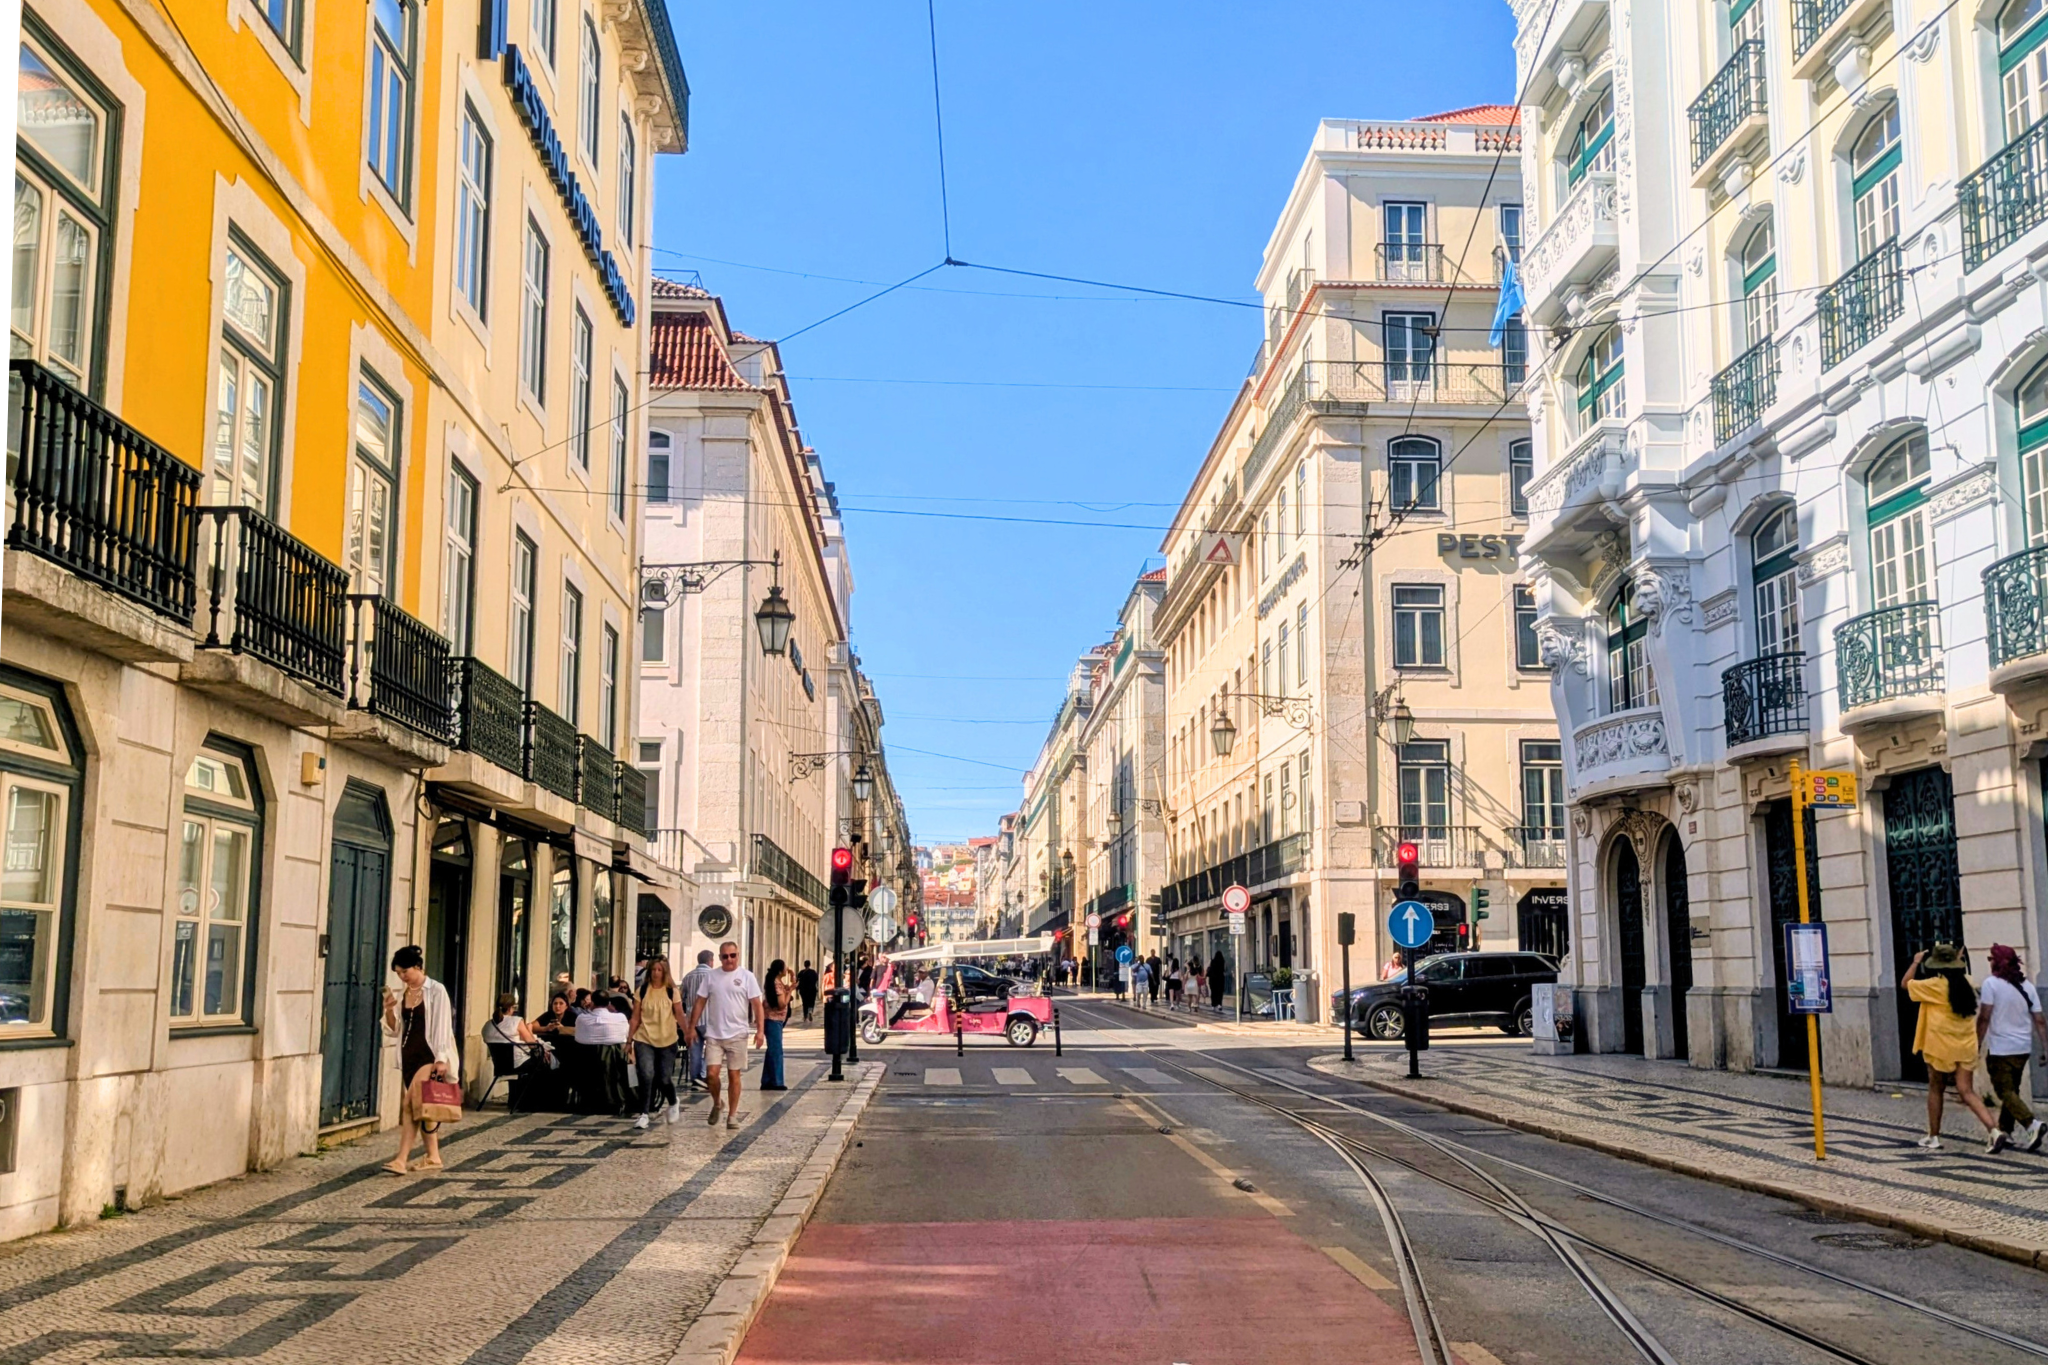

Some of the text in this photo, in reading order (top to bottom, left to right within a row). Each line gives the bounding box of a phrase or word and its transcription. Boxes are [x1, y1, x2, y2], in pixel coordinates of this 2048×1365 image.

[506, 44, 636, 327] PESTANA HOTEL GROUP
